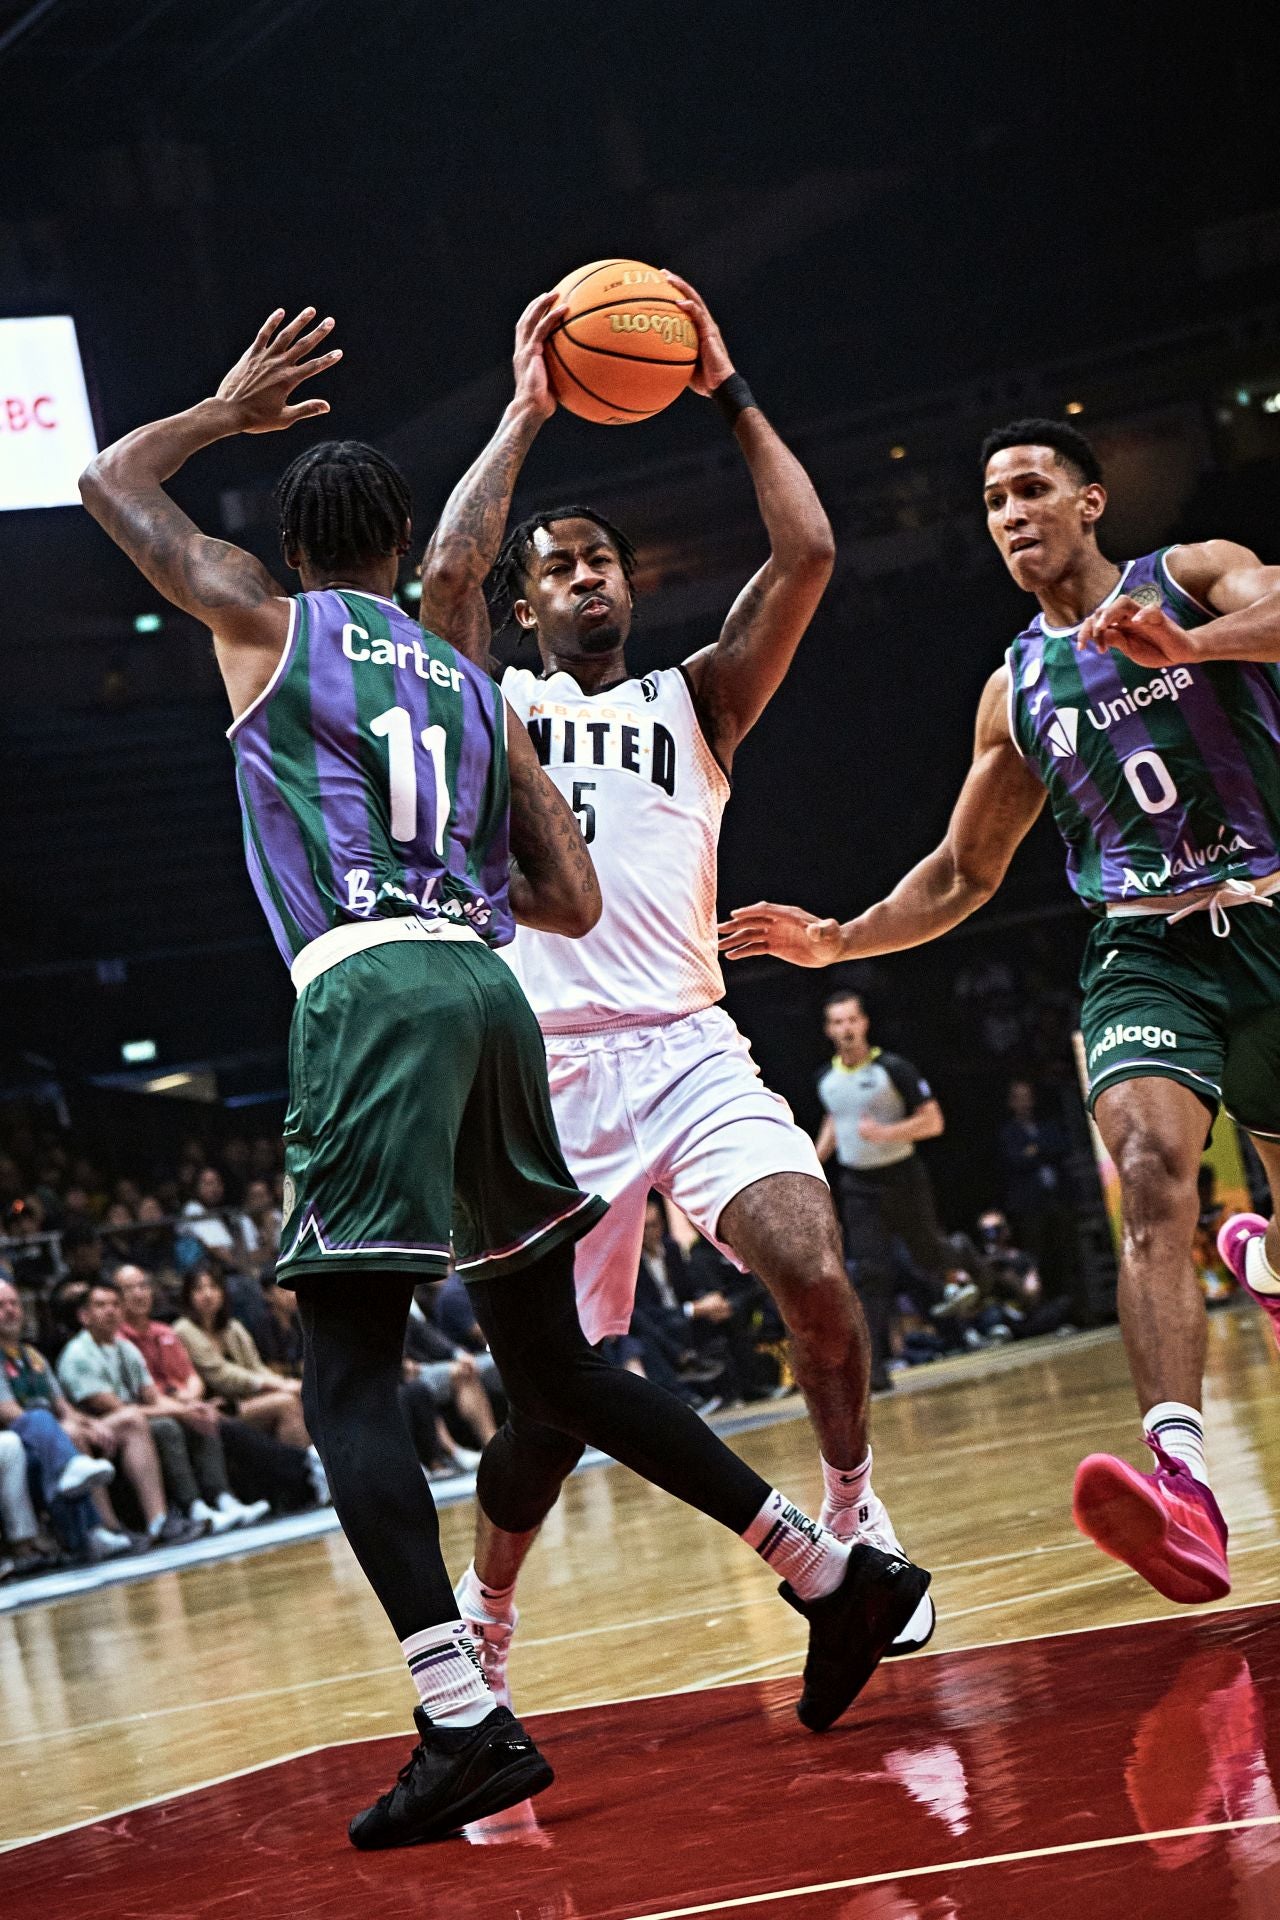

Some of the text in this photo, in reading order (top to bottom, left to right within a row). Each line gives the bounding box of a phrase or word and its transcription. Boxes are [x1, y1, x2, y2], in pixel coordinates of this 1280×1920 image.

[0, 396, 57, 432] BC
[342, 623, 465, 692] Carter
[1086, 667, 1194, 730] Unicaja
[370, 707, 450, 856] 11
[527, 718, 676, 797] NITED
[1124, 751, 1177, 814] 0
[573, 782, 596, 844] 5
[781, 1504, 824, 1544] UNICAJ
